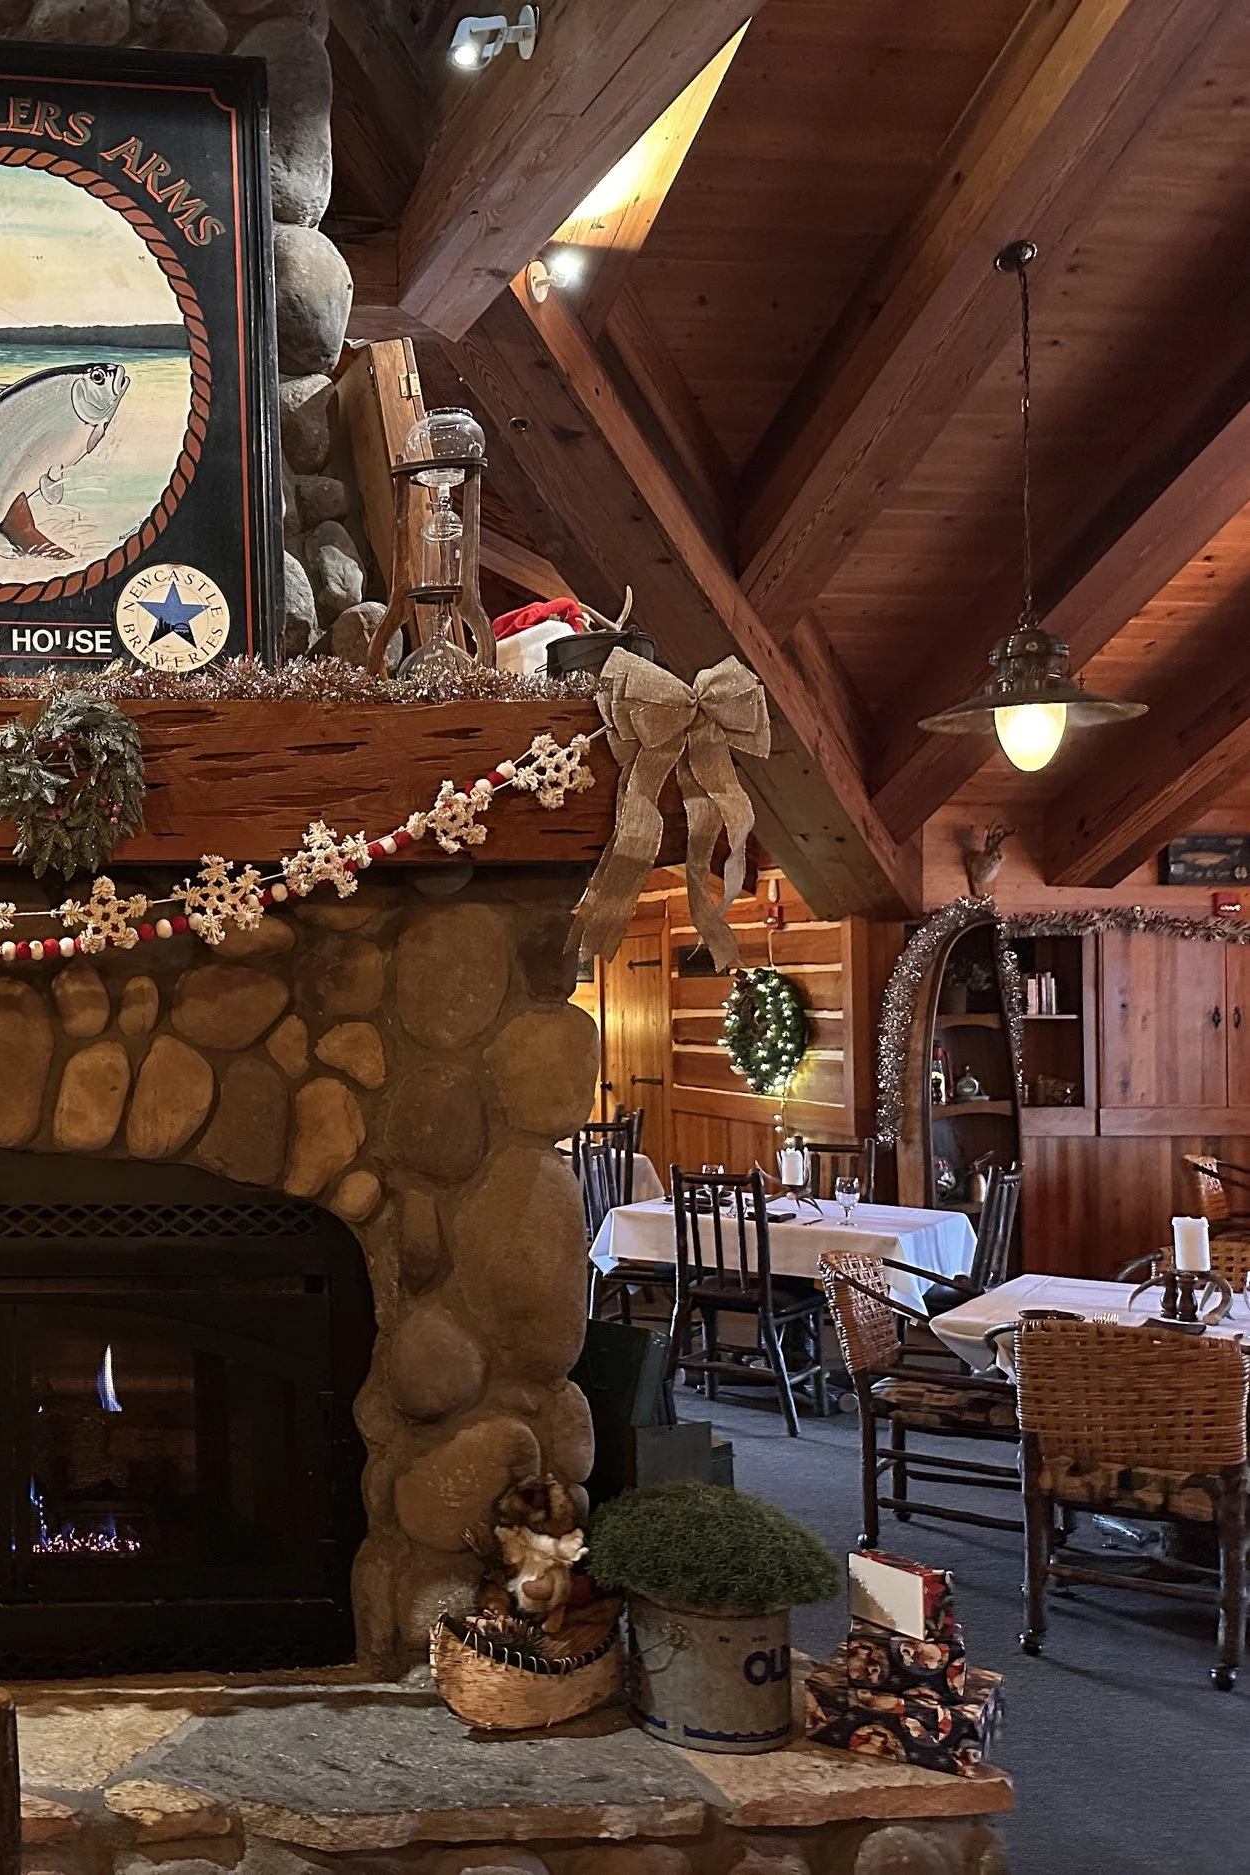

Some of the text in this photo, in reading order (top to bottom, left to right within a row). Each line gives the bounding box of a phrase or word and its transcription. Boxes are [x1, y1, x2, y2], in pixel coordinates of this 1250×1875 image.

[99, 136, 226, 247] ARMS
[123, 569, 224, 618] NEWCASTLE
[123, 623, 224, 669] BREWERIES
